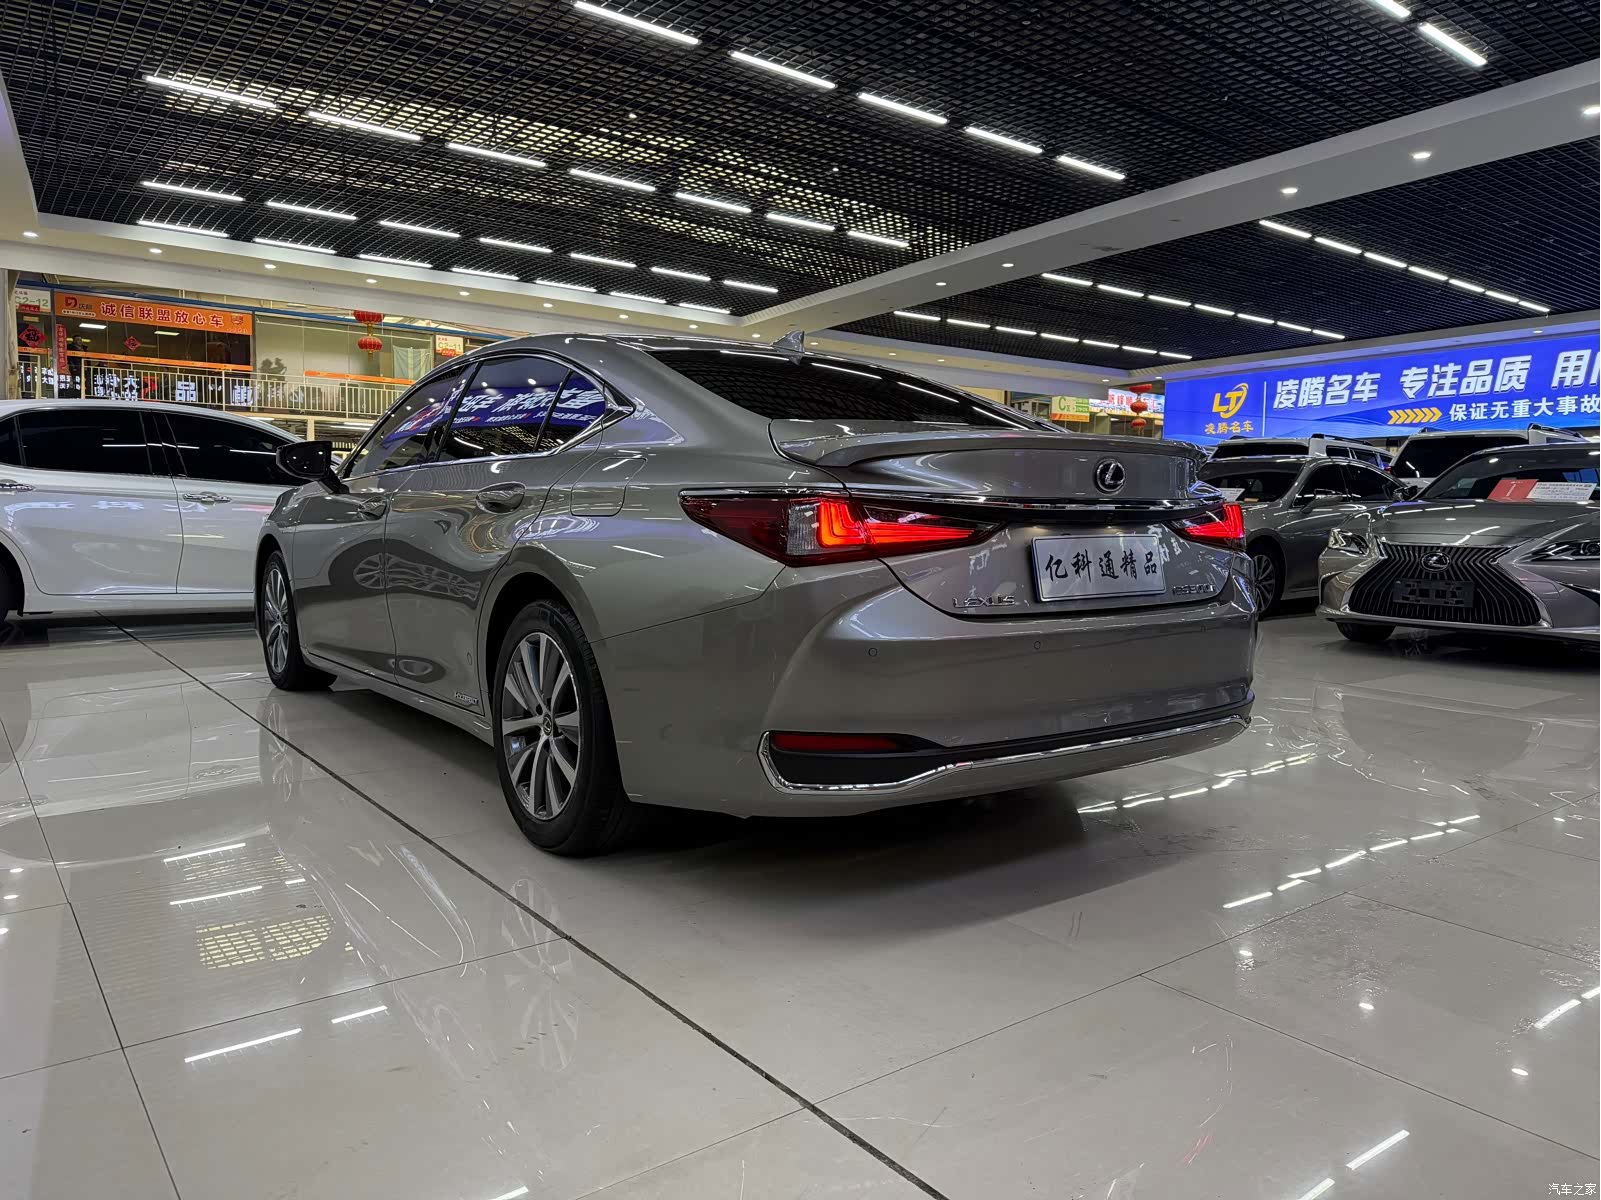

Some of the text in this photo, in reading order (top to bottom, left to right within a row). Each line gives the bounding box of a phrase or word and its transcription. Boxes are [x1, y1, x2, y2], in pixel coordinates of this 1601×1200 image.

[15, 296, 49, 308] C2-12
[100, 302, 224, 328] 诚信联盟放心车
[1273, 349, 1600, 409] 凌腾名车 专注品质 用
[1212, 388, 1246, 416] LT
[1449, 393, 1600, 422] 保证无重大事故
[1204, 421, 1254, 435] 凌腾名车
[1045, 549, 1157, 583] 亿科通精品
[953, 595, 1015, 608] LEXUS
